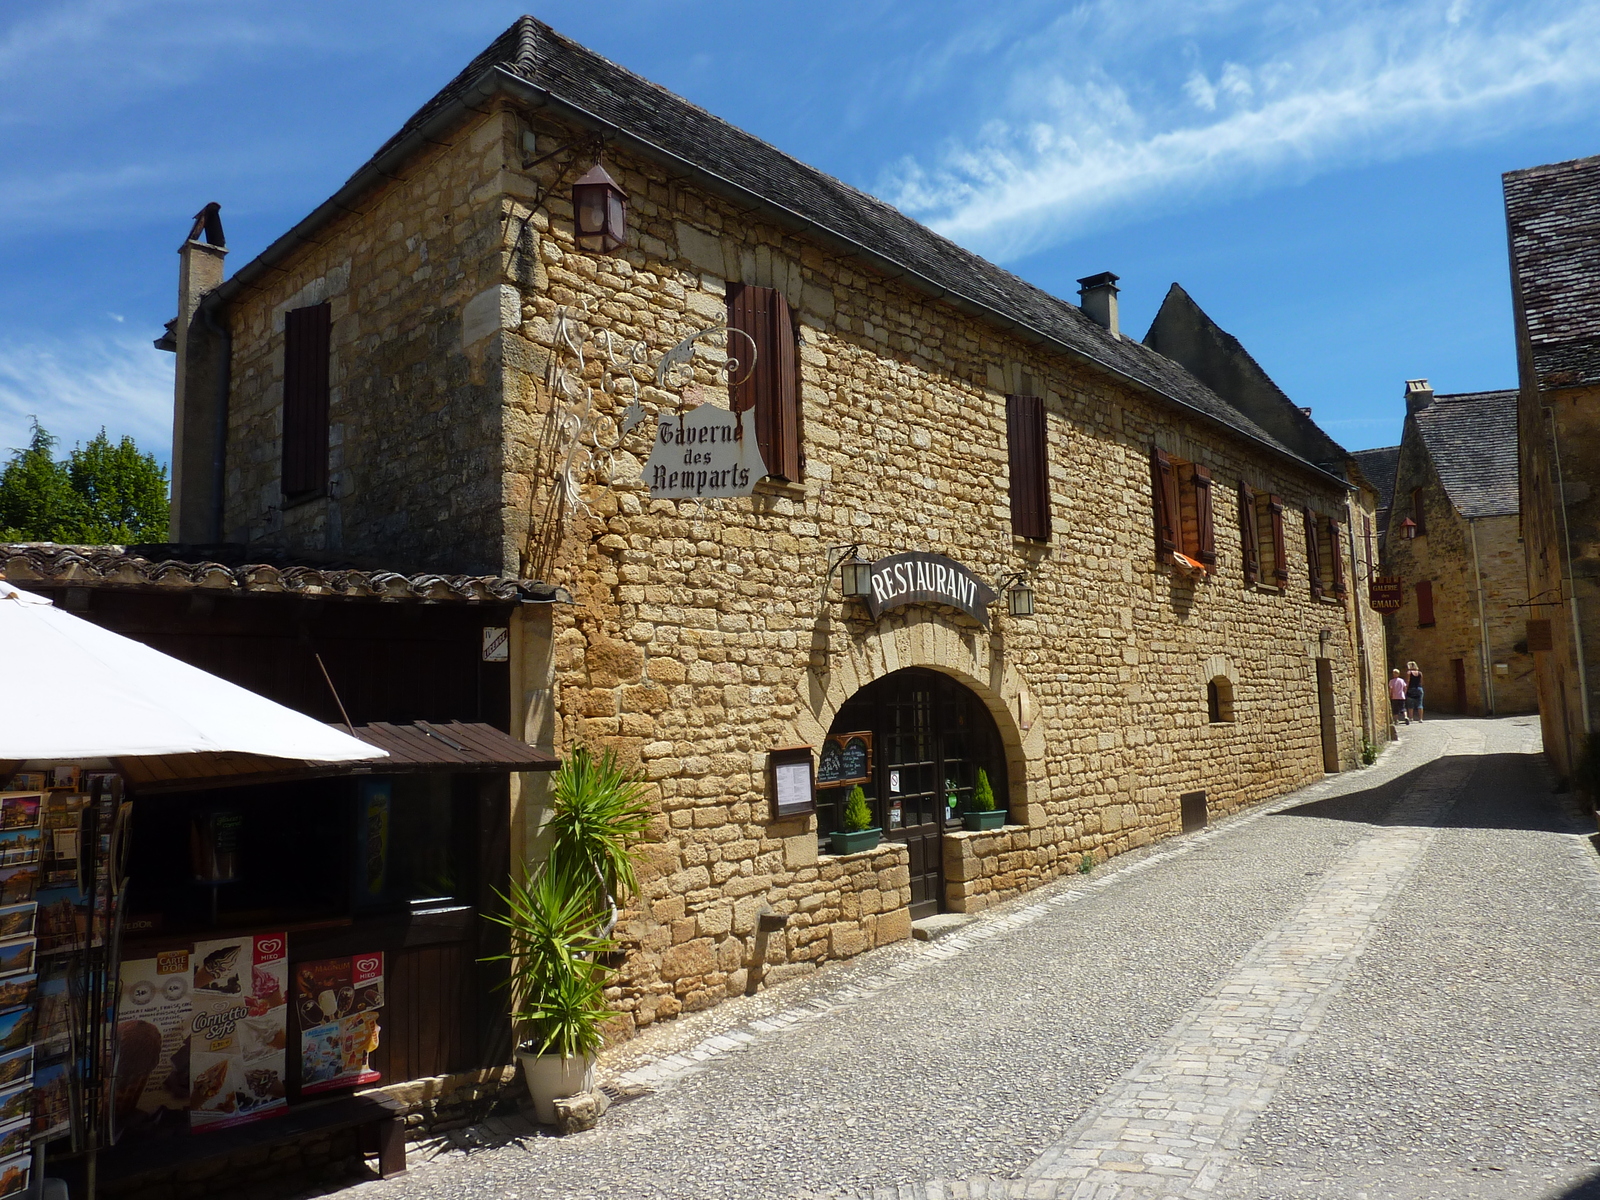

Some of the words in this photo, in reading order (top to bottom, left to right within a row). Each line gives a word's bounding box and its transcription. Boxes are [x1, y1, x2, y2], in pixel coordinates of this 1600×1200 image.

[658, 421, 743, 446] Taverne
[683, 448, 711, 465] des
[651, 463, 750, 494] Remparts
[871, 561, 978, 608] RESTAURANT
[1371, 600, 1400, 608] EMAUX
[159, 956, 186, 966] CARTE
[261, 953, 279, 961] MIKO
[163, 963, 184, 972] D'OR
[316, 962, 350, 973] MAGNUM
[192, 1006, 248, 1033] Cornetto
[205, 1020, 237, 1039] Soft
